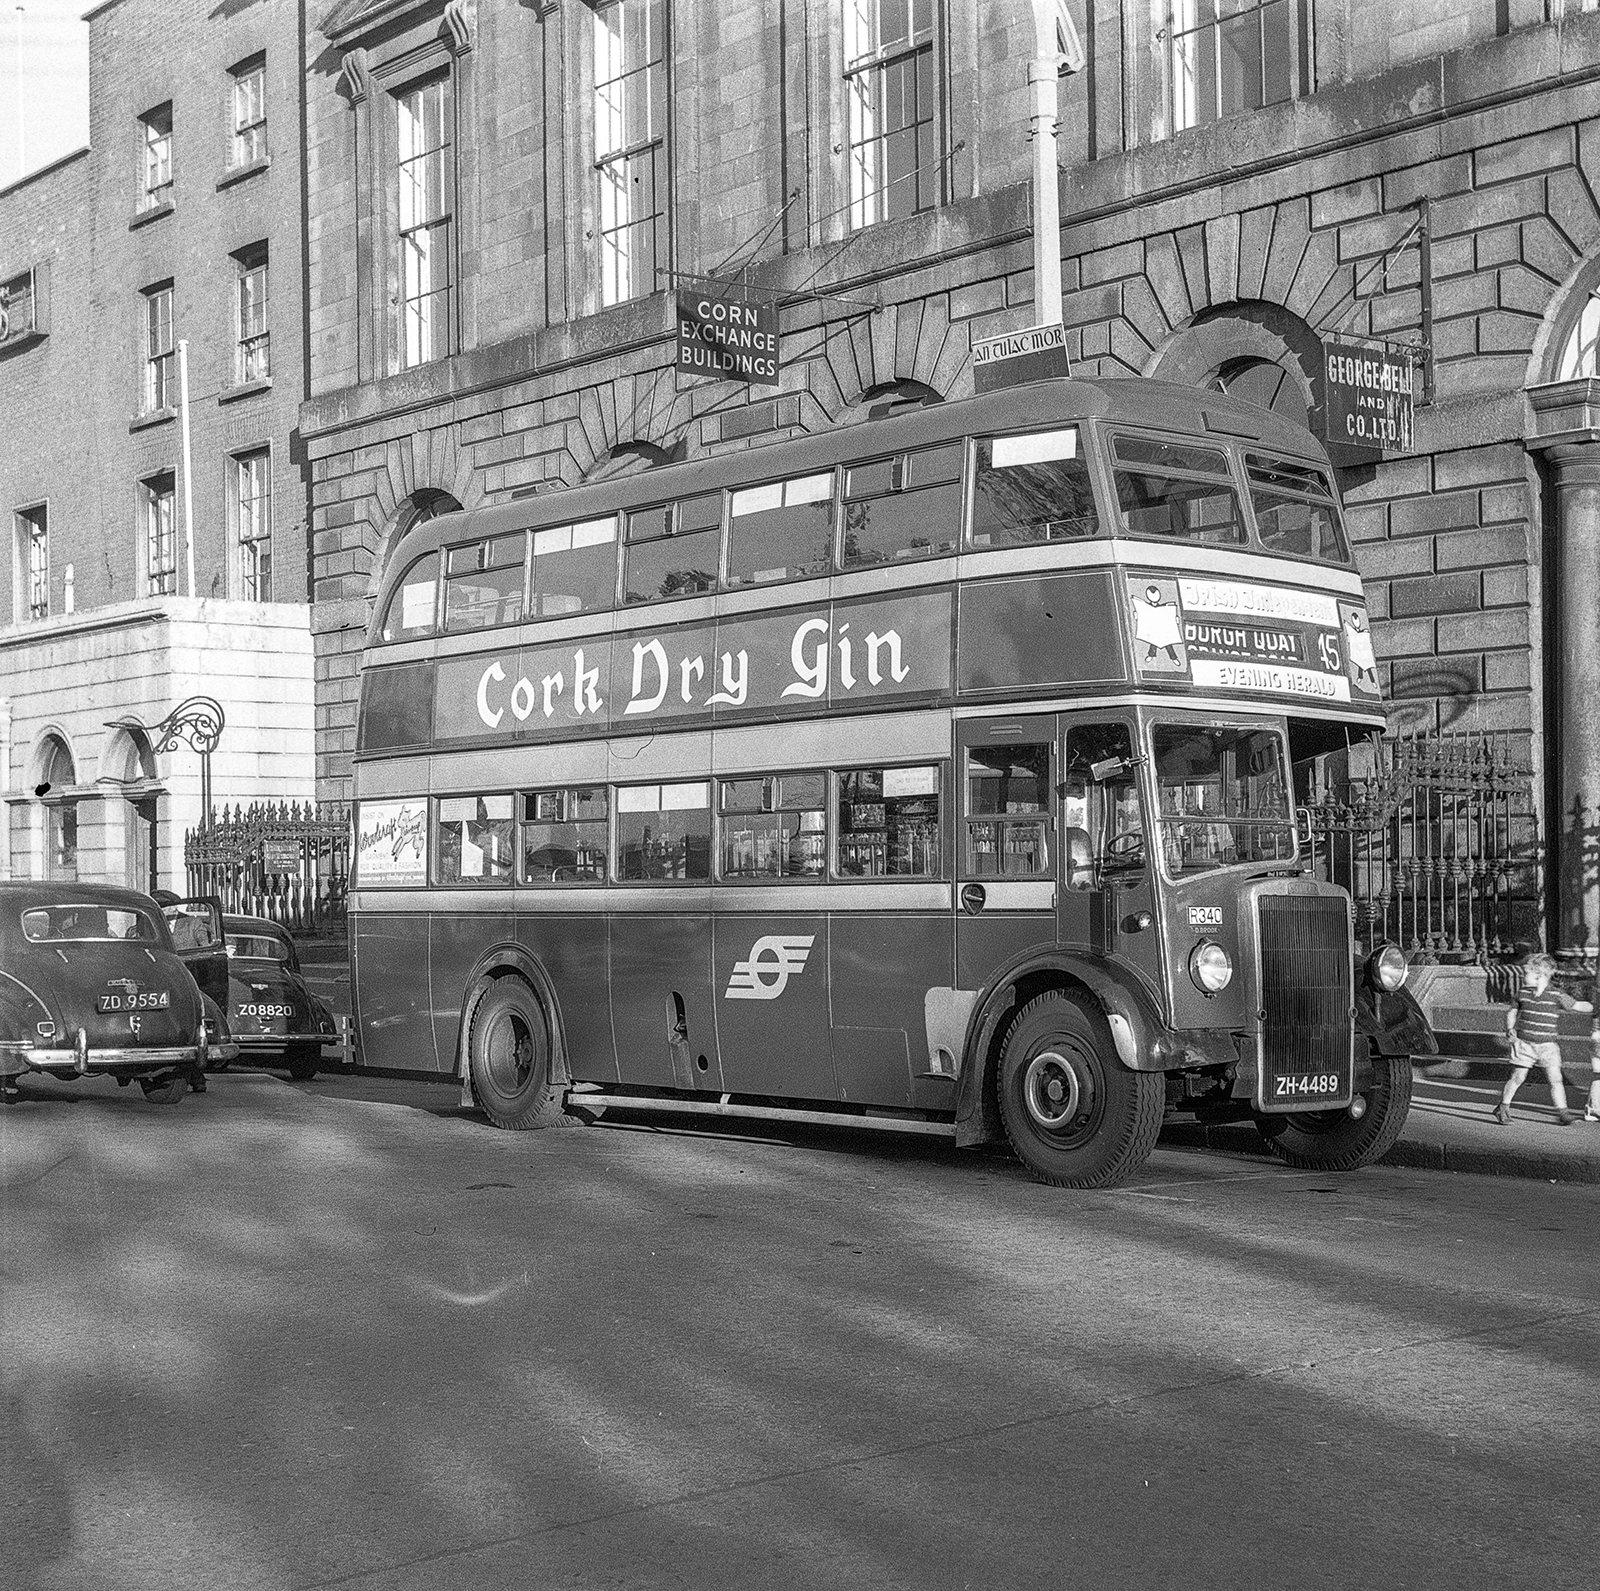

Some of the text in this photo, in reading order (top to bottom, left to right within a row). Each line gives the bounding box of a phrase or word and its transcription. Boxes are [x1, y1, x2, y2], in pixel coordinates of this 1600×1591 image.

[697, 300, 758, 327] CORN
[681, 319, 776, 352] EXCHANGE
[681, 345, 776, 377] BUILDINGS
[1328, 354, 1380, 390] GEORGE
[1359, 395, 1385, 410] AND
[1185, 624, 1247, 648] BURGH
[476, 617, 911, 729] Cork Dry Gin
[1219, 666, 1336, 697] EVENING HERALD
[1190, 908, 1222, 924] R340
[100, 992, 168, 1010] ZD 9554
